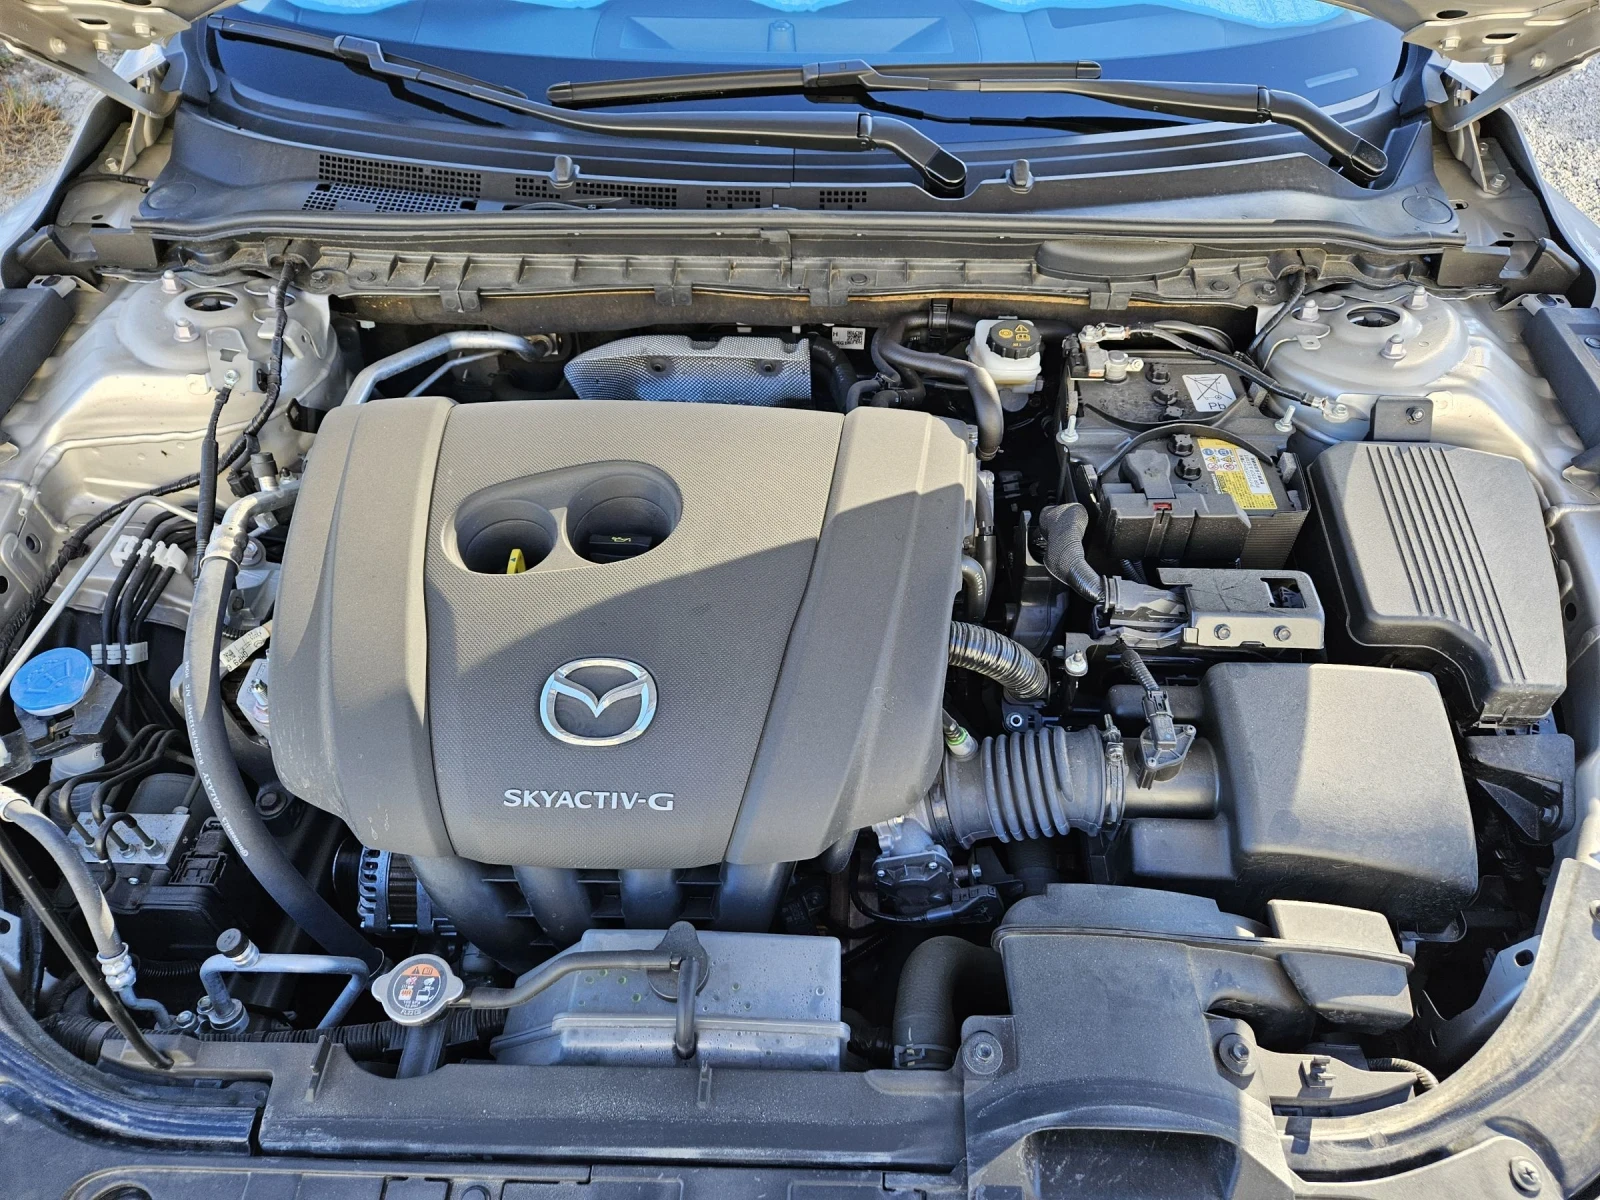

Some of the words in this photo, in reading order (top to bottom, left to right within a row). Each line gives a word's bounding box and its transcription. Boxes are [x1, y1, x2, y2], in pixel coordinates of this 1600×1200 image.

[1208, 402, 1227, 410] Pb
[202, 772, 222, 809] GALAXY
[503, 788, 674, 811] SKYACTIV-G
